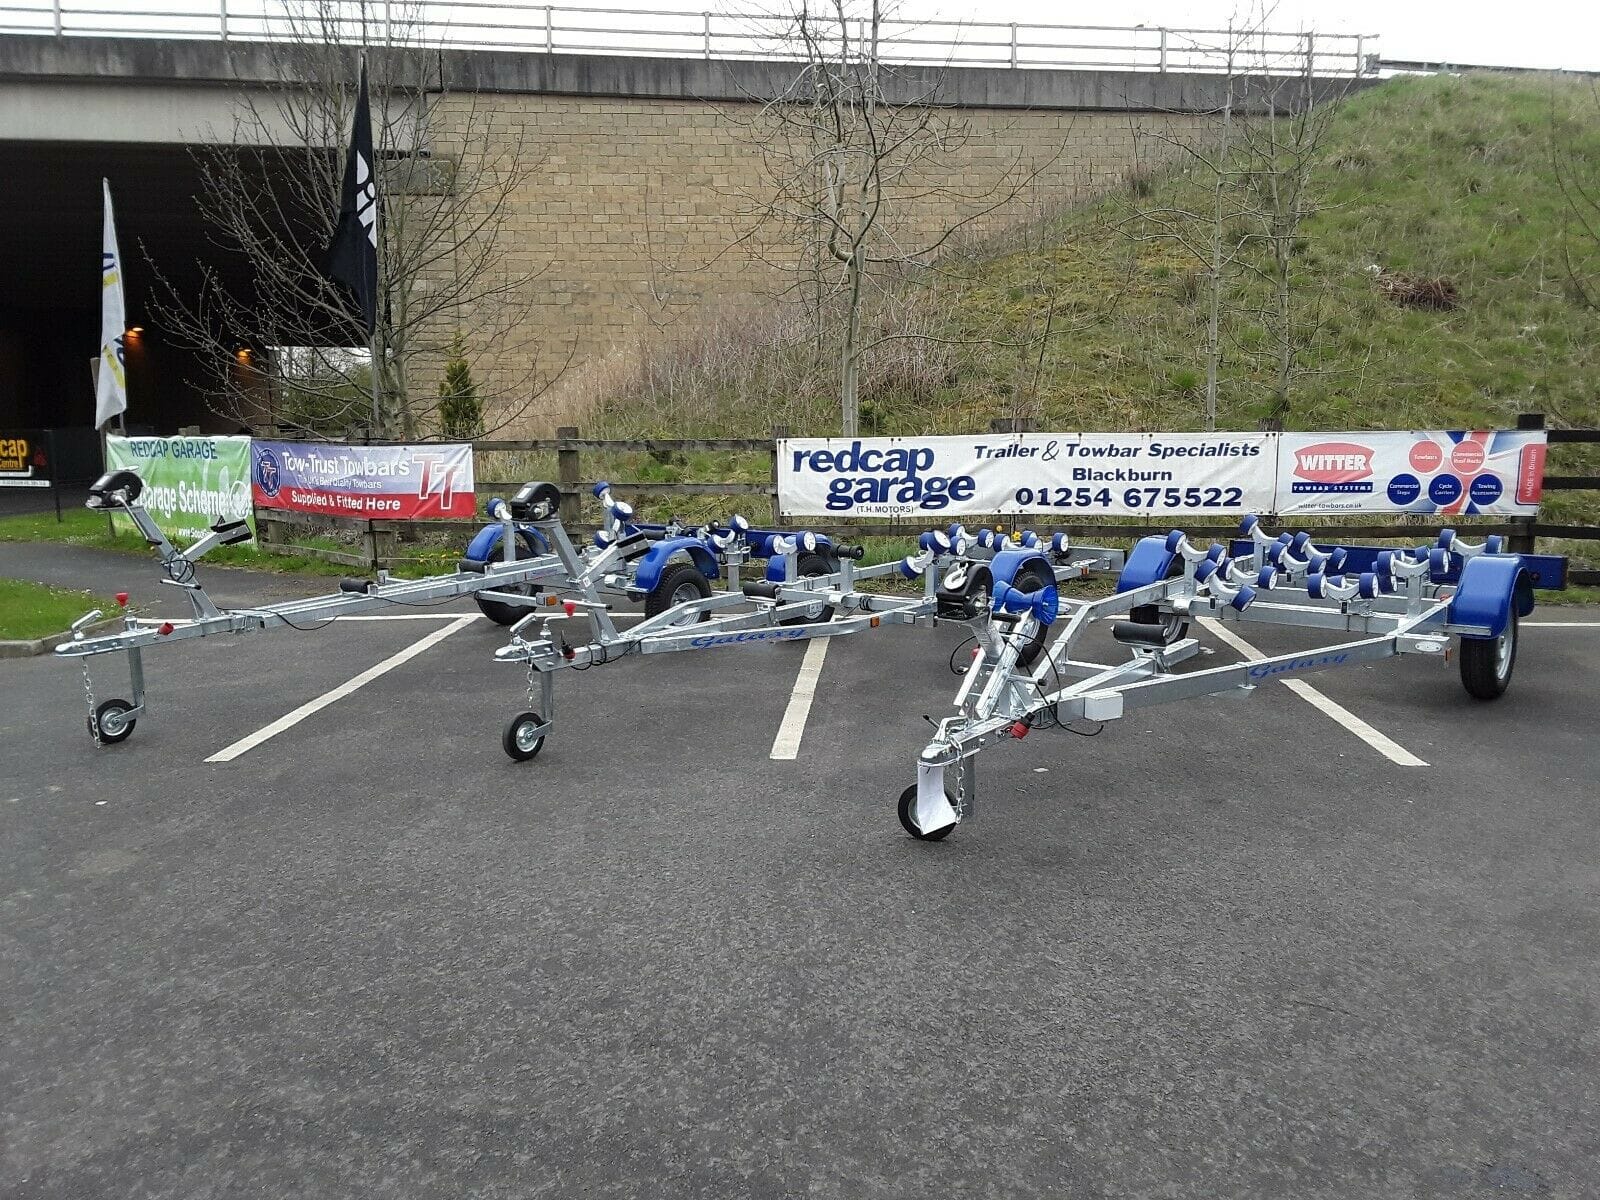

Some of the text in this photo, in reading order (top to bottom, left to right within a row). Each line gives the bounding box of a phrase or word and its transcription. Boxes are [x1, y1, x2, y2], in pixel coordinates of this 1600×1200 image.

[130, 440, 218, 460] REDCAP GARAGE
[793, 441, 935, 477] redcap
[974, 440, 1260, 461] Trailer & Towbar Specialists
[281, 451, 340, 475] Tow-Trust
[340, 455, 410, 476] Towbars
[1300, 454, 1367, 471] WITTER
[353, 479, 382, 489] Towbars
[1072, 467, 1173, 481] Blackburn
[291, 490, 327, 507] Supplied
[329, 495, 335, 507] &
[337, 496, 363, 510] Fitted
[365, 497, 401, 511] Here
[825, 475, 976, 511] garage
[1015, 487, 1243, 507] 01254 675522
[690, 628, 806, 648] Galaxy
[1249, 653, 1353, 678] Galaxy
